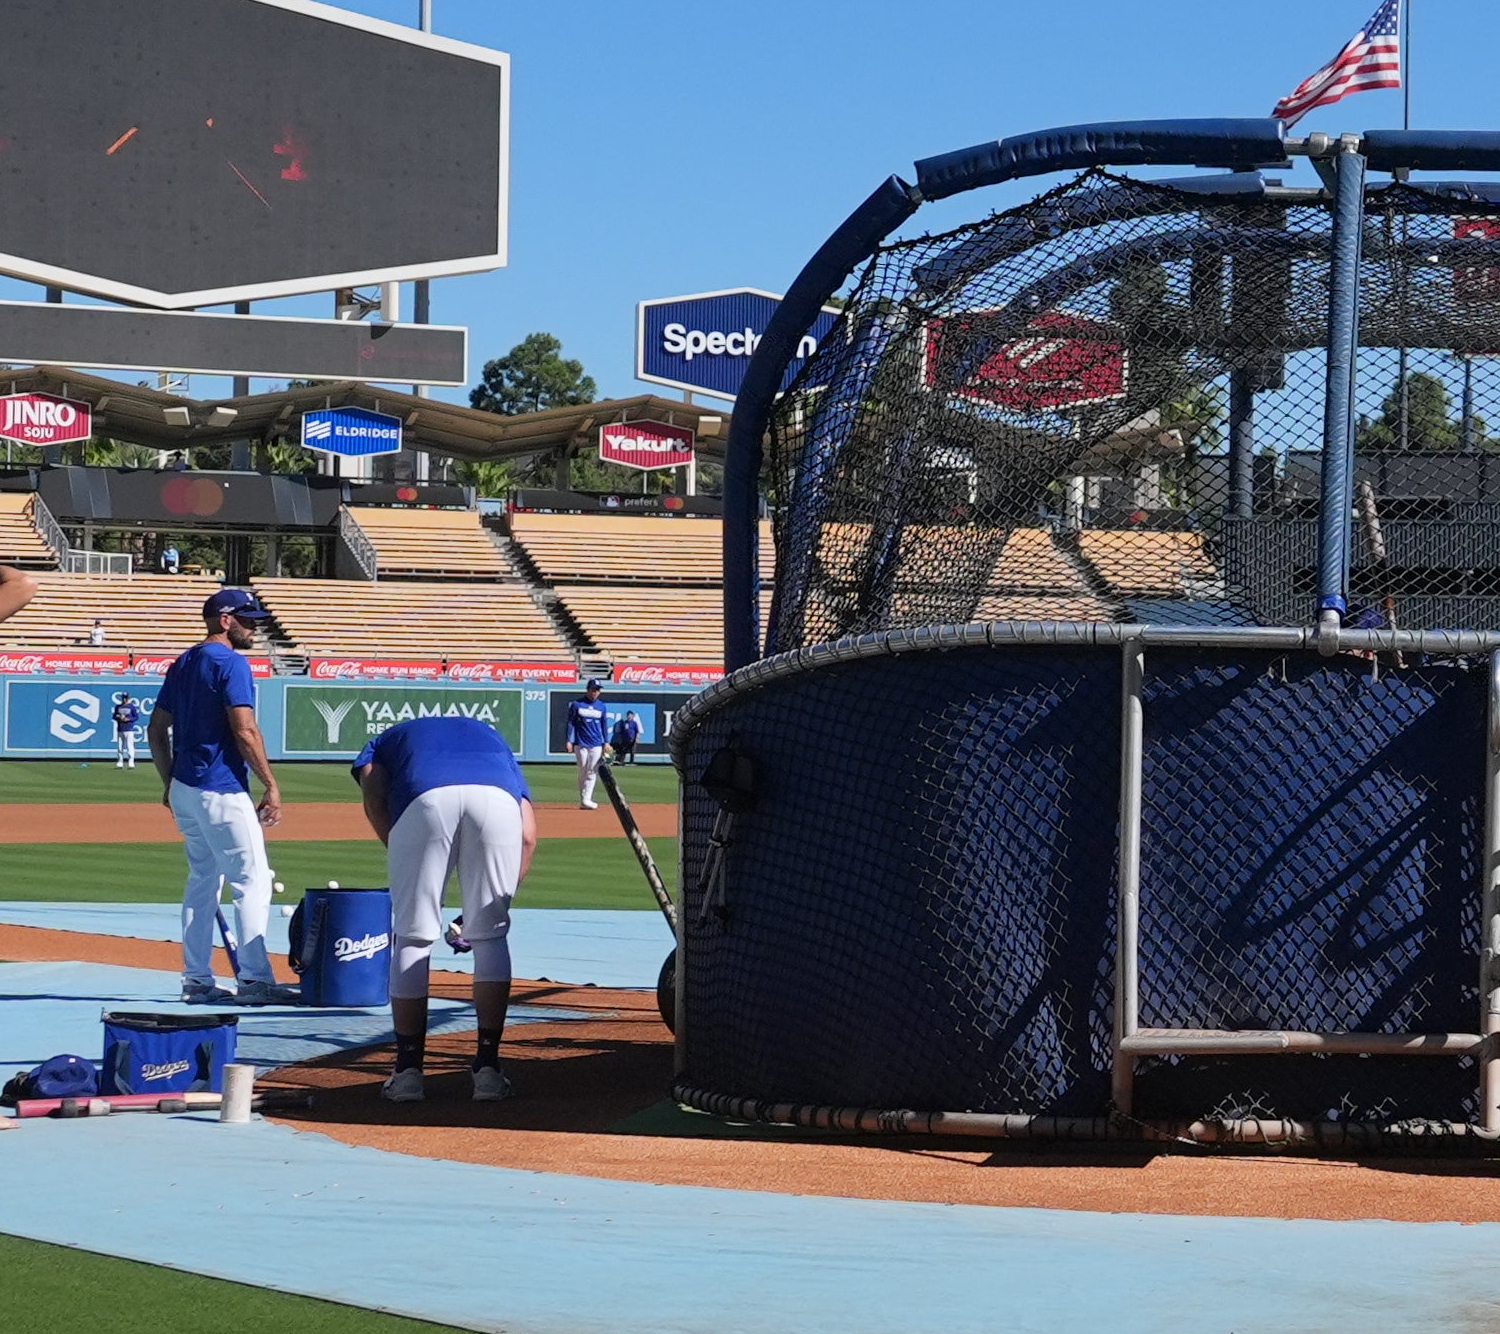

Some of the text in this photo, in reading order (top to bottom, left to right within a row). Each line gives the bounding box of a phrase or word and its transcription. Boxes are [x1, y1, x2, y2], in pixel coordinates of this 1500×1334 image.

[664, 322, 818, 361] Spectm
[3, 400, 77, 431] JINRO
[24, 426, 55, 439] SOJU
[335, 425, 398, 440] ELDRIDGE
[605, 433, 691, 455] Yakult
[624, 496, 659, 509] prefers
[45, 660, 72, 668] HOME
[74, 660, 91, 669] RUN
[93, 661, 124, 670] MAGIC
[315, 661, 437, 678] Coca-Cola HOME RUN MAGIC
[448, 663, 494, 678] Coca-Cola
[504, 669, 520, 677] HIT
[522, 669, 551, 678] EVERY
[553, 670, 575, 678] TIME
[620, 666, 665, 681] Coca-Cola
[666, 672, 690, 680] HOME
[525, 690, 546, 701] 375
[334, 932, 390, 962] Dodgers
[141, 1059, 190, 1082] Dodgers
